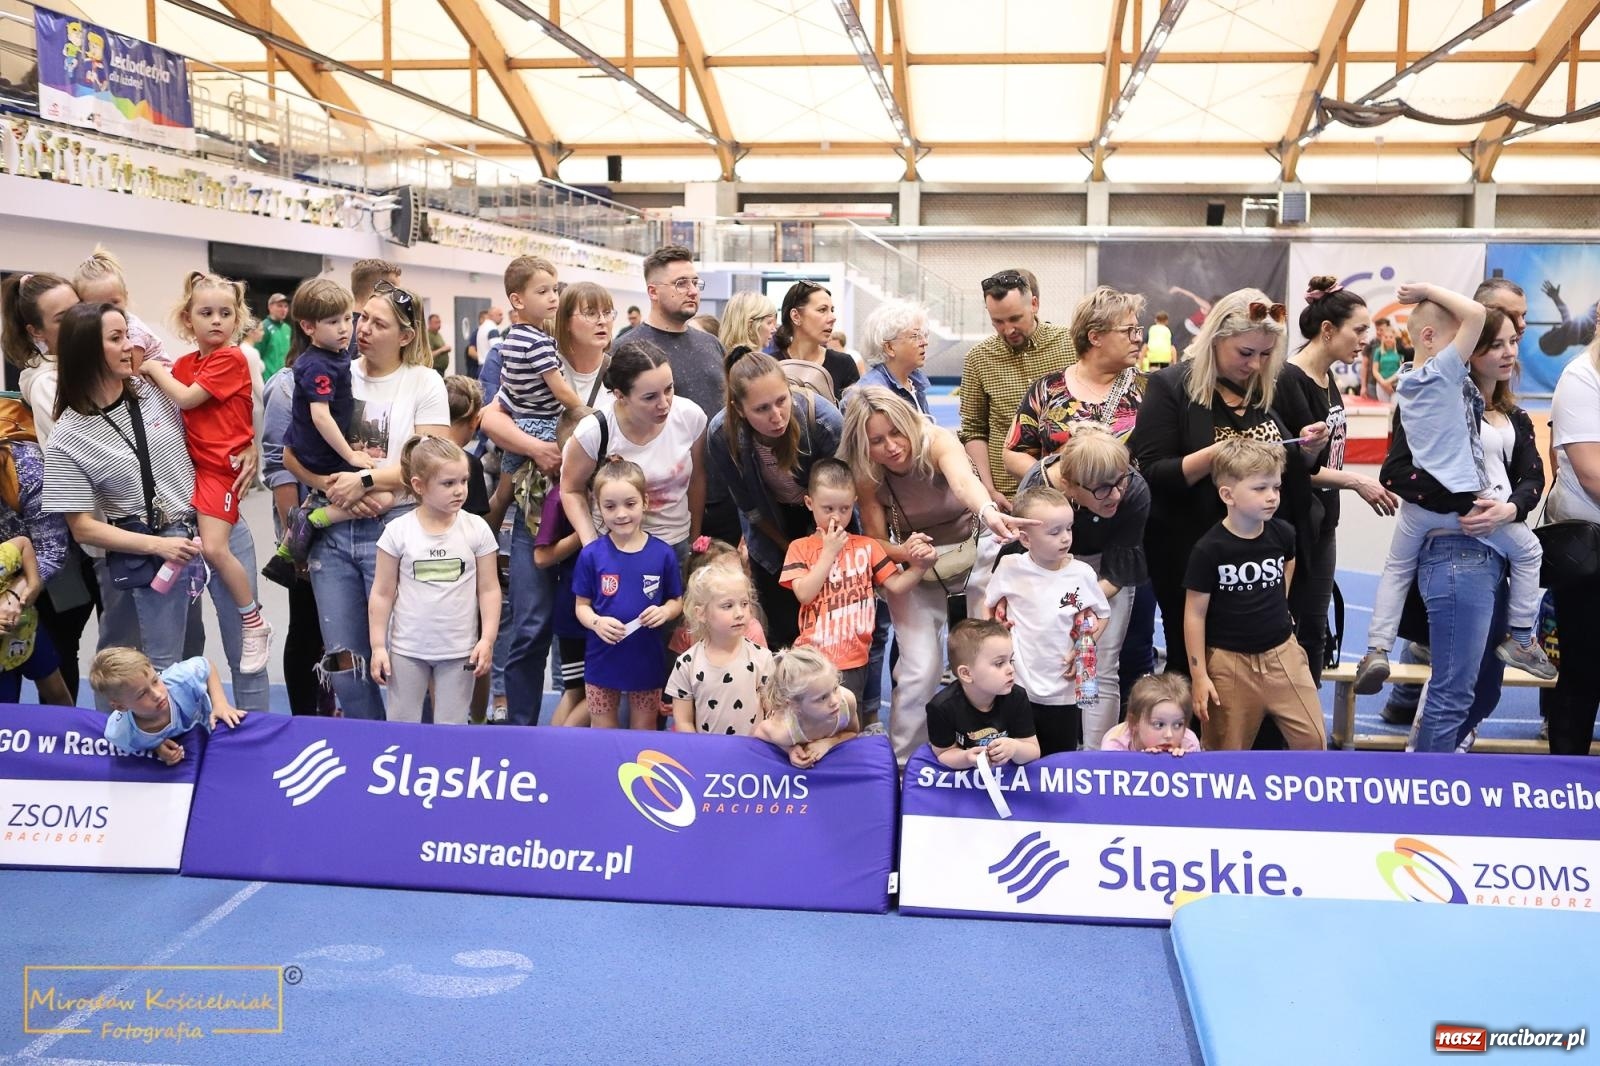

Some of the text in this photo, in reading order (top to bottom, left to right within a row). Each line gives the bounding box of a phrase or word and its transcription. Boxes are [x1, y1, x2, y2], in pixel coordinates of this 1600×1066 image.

[315, 375, 333, 395] 3
[224, 493, 232, 512] 9
[429, 548, 447, 558] KID
[38, 735, 57, 754] w
[366, 745, 550, 809] Śląskie.
[702, 773, 809, 800] ZSOMS
[1040, 768, 1257, 800] MISTRZOSTWA
[1264, 775, 1472, 807] SPORTOWEGO
[1480, 786, 1503, 808] w
[8, 803, 109, 829] ZSOMS
[702, 801, 808, 815] RACIBÓRZ
[3, 831, 105, 843] RACIBÓRZ
[420, 839, 633, 880] smsraciborz.pl
[1098, 836, 1303, 905] Śląskie.
[1472, 863, 1591, 893] ZSOMS
[1475, 893, 1593, 909] RACIBÓRZ
